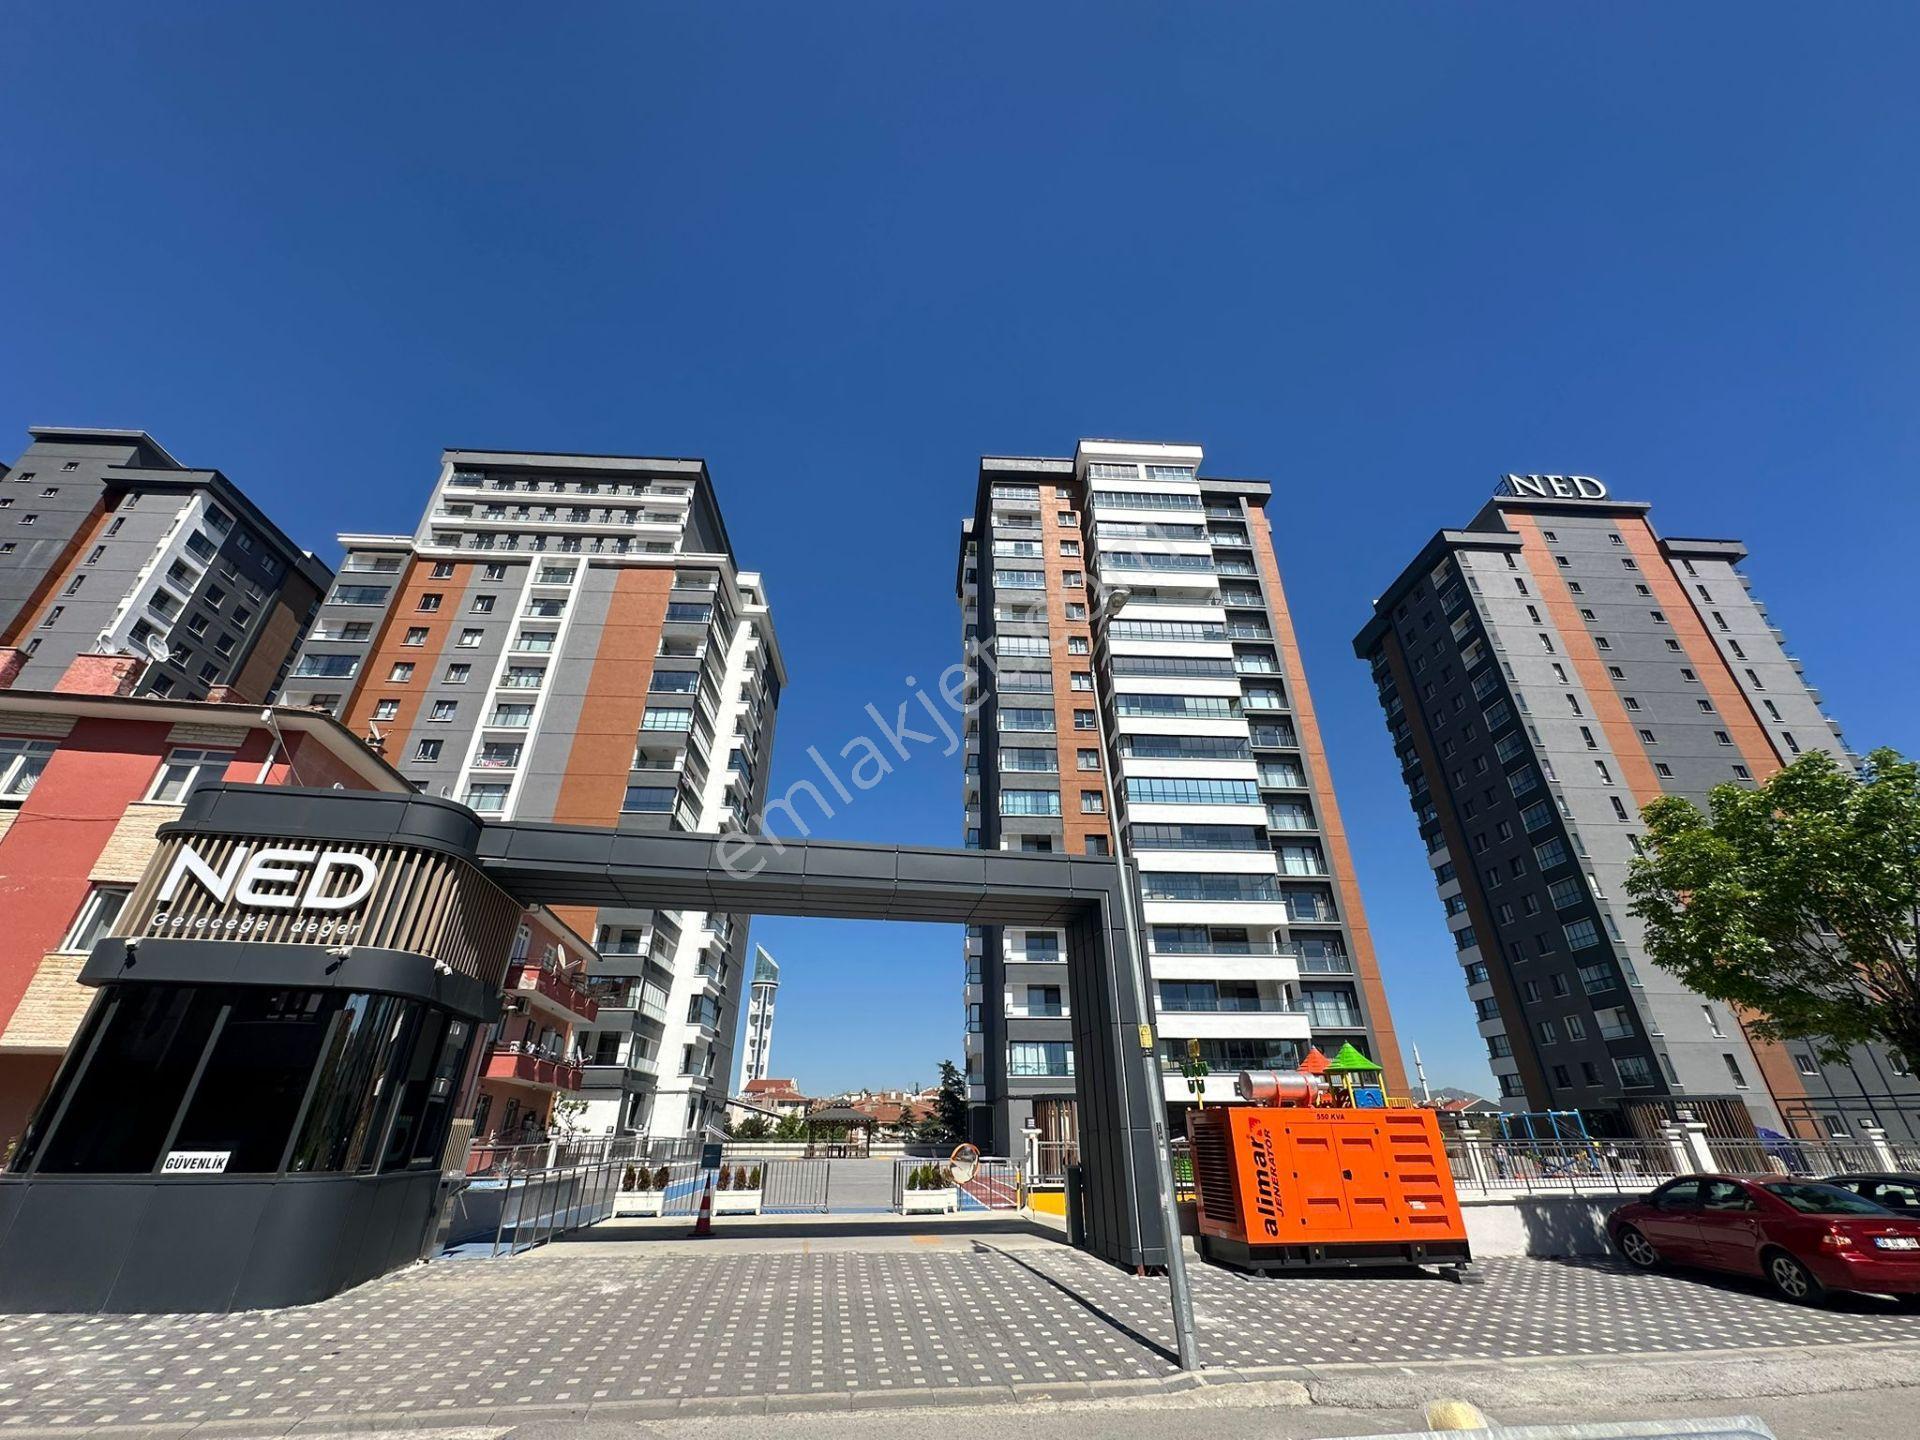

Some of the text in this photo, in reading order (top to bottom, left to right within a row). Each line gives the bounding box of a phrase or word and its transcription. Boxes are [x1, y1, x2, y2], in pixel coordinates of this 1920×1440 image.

[1508, 473, 1607, 499] NED
[156, 844, 379, 909] NED
[152, 912, 361, 938] Geleceğe değer
[165, 1154, 226, 1170] GÜVENLİK
[1264, 1128, 1285, 1218] JENERATOR
[1250, 1135, 1279, 1237] alimar
